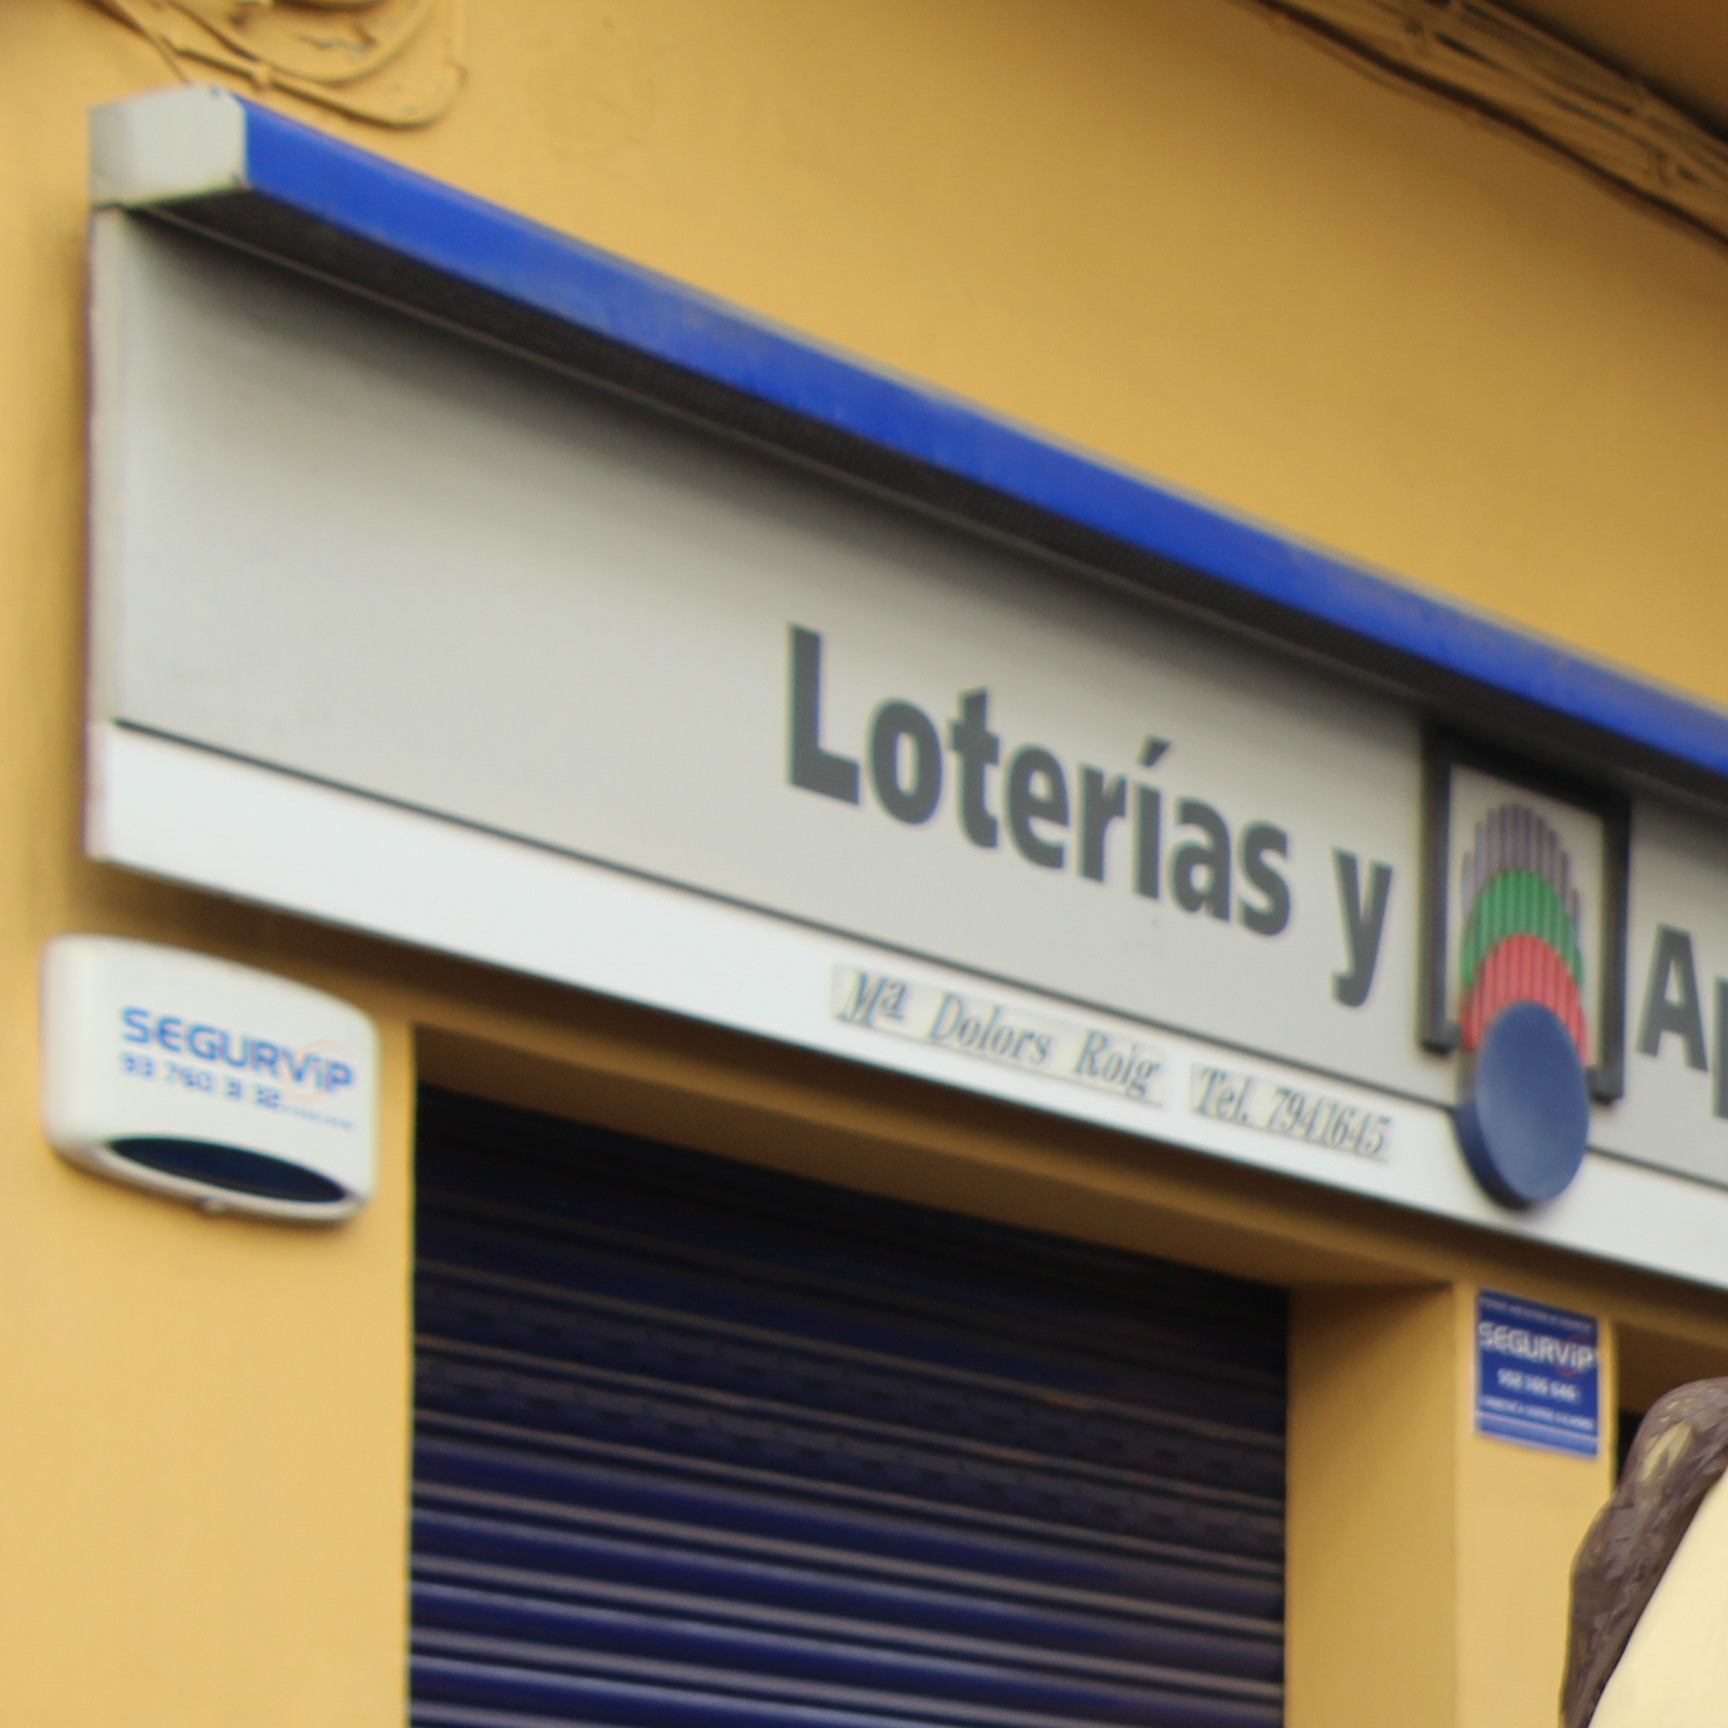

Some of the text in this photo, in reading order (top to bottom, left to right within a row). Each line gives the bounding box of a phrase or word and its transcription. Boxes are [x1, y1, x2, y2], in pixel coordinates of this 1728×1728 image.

[787, 623, 1292, 937] Loterías
[1332, 846, 1394, 1009] y
[928, 992, 1053, 1066] Dolors
[1073, 1029, 1160, 1098] Roig
[1194, 1065, 1250, 1126] Tel.
